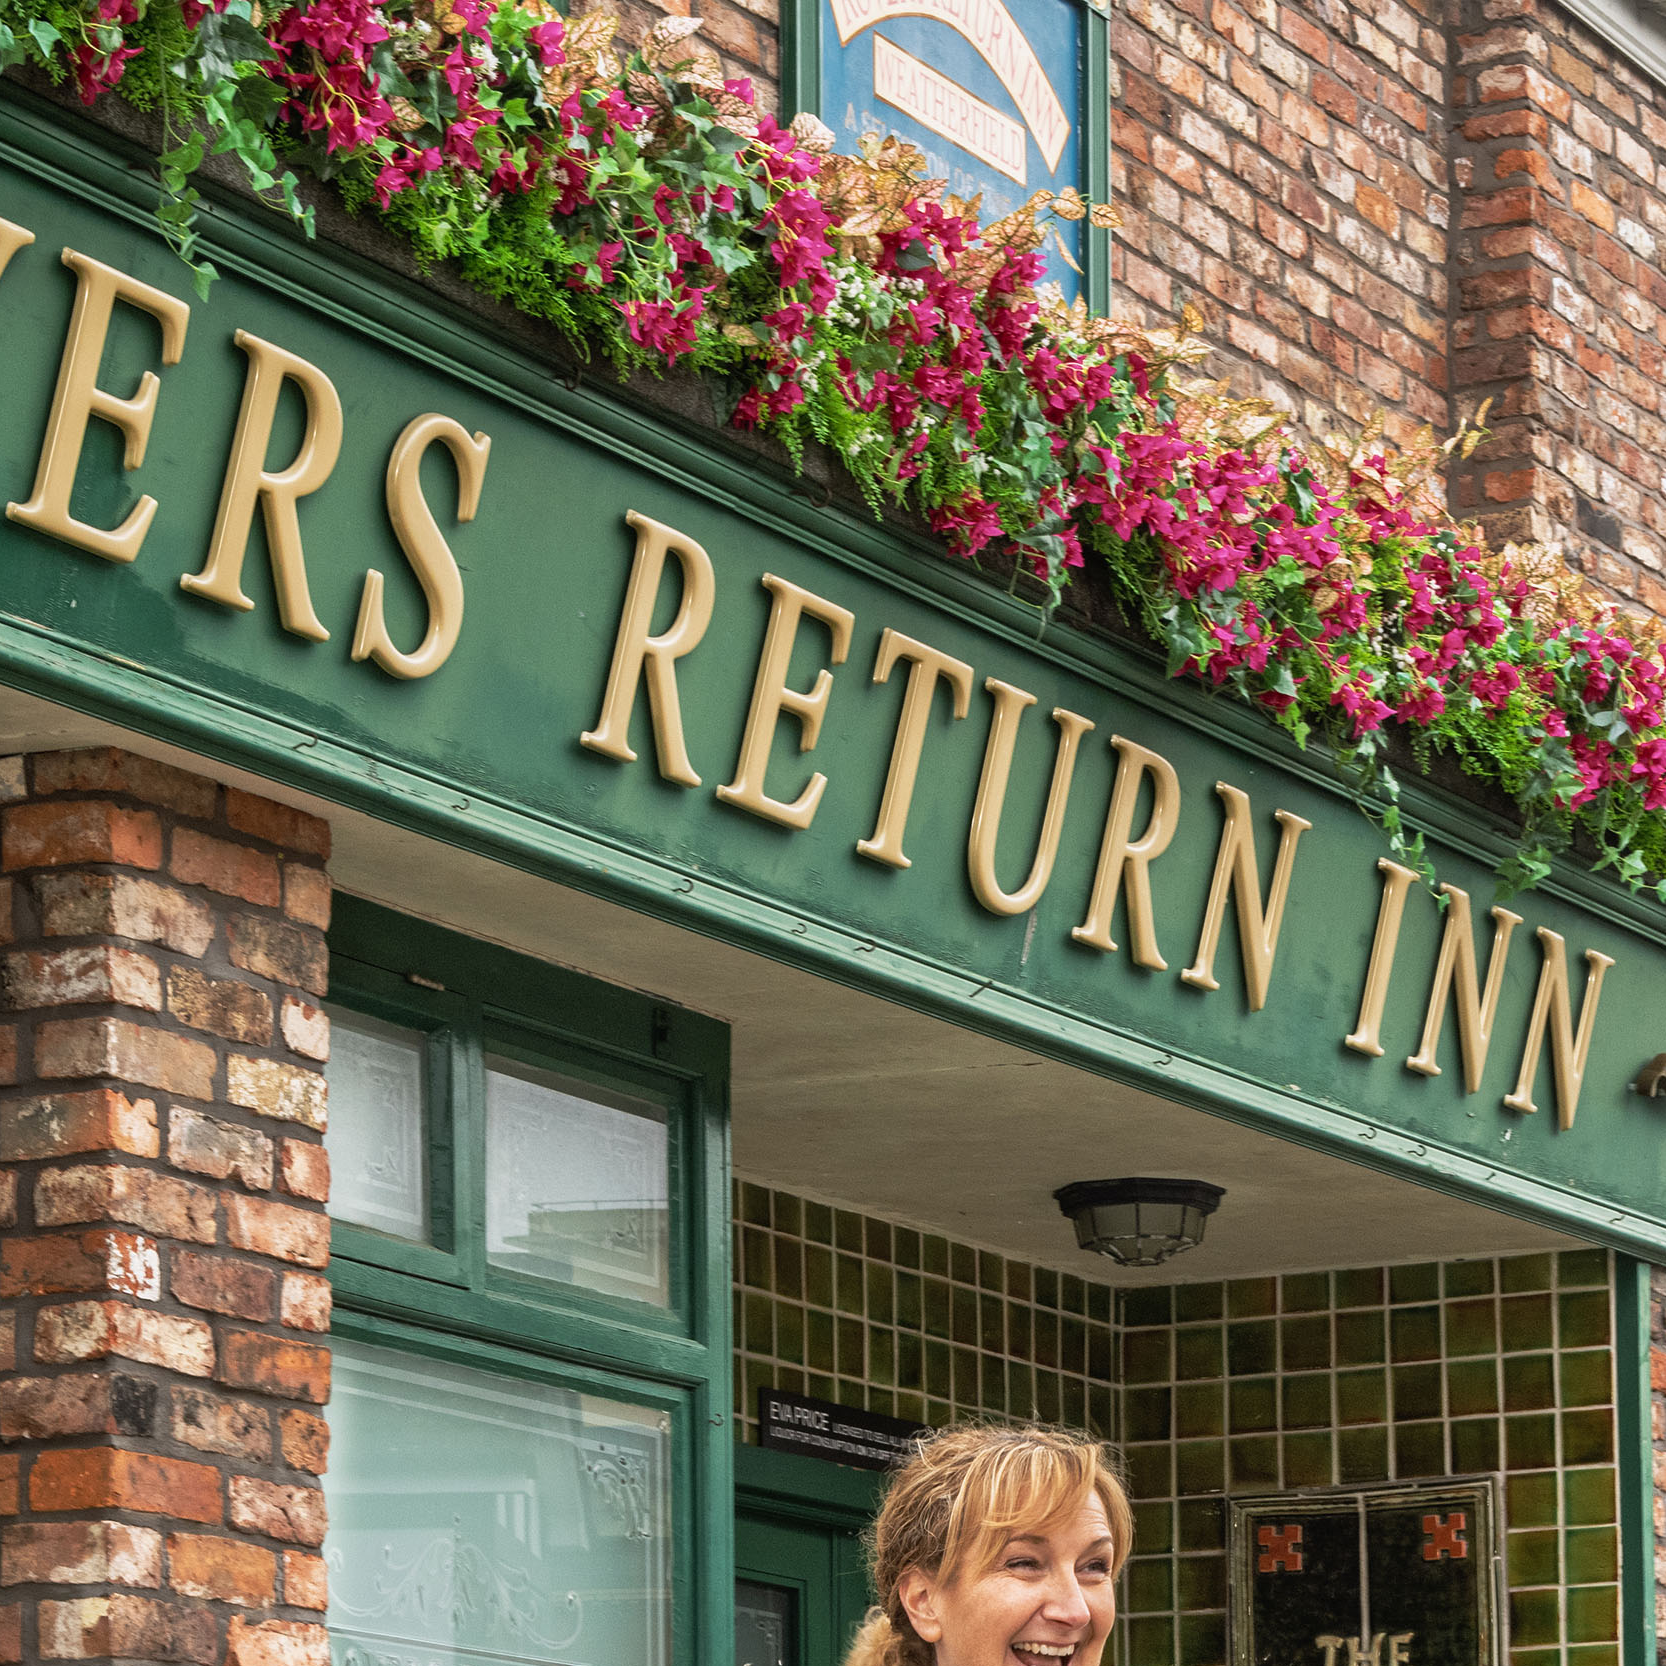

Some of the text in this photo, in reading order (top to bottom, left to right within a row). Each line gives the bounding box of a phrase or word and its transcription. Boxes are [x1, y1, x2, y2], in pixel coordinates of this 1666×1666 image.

[877, 45, 1023, 171] WEATHERFIELD
[579, 508, 1313, 1013] RETURN
[1344, 856, 1616, 1131] INN
[769, 1400, 794, 1424] EVA
[794, 1406, 830, 1432] PRICE
